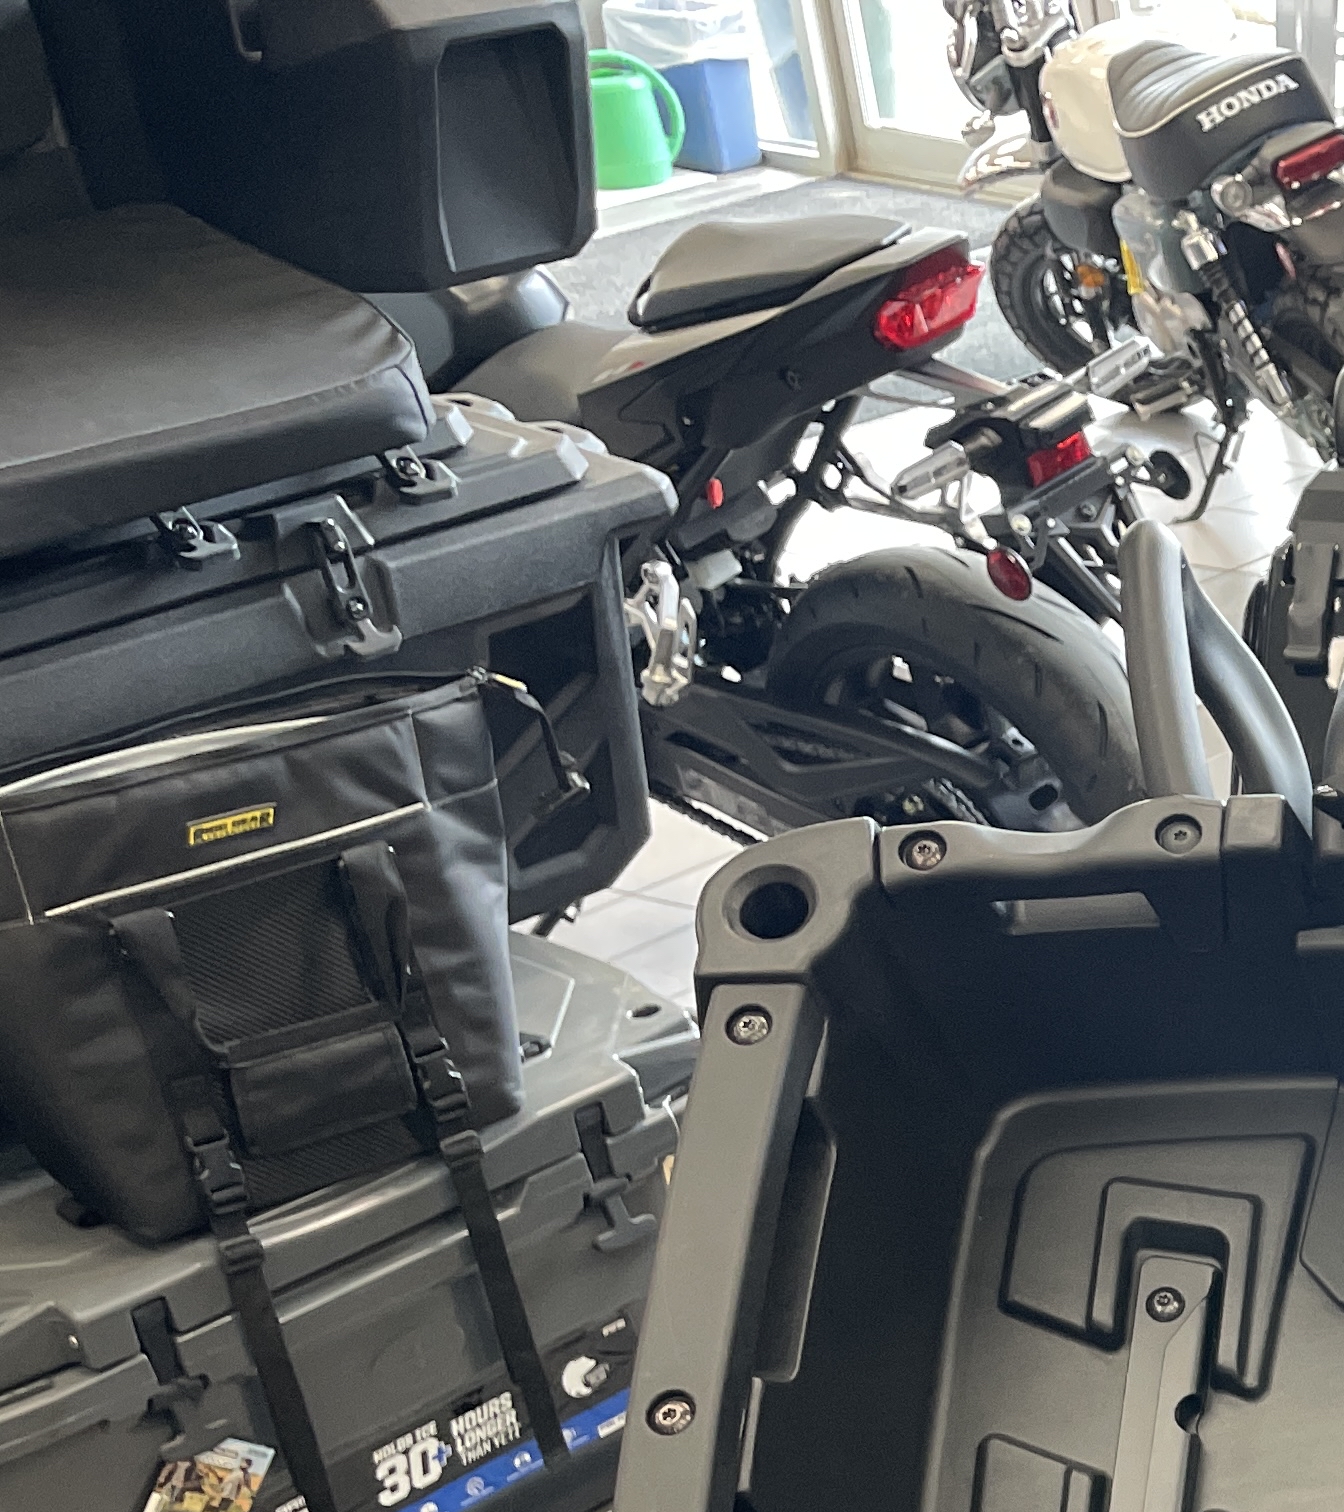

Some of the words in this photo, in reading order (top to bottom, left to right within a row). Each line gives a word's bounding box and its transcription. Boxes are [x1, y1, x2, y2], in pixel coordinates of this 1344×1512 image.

[1195, 72, 1300, 133] HONDA
[450, 1391, 513, 1437] HOURS
[455, 1408, 518, 1450] LONGER
